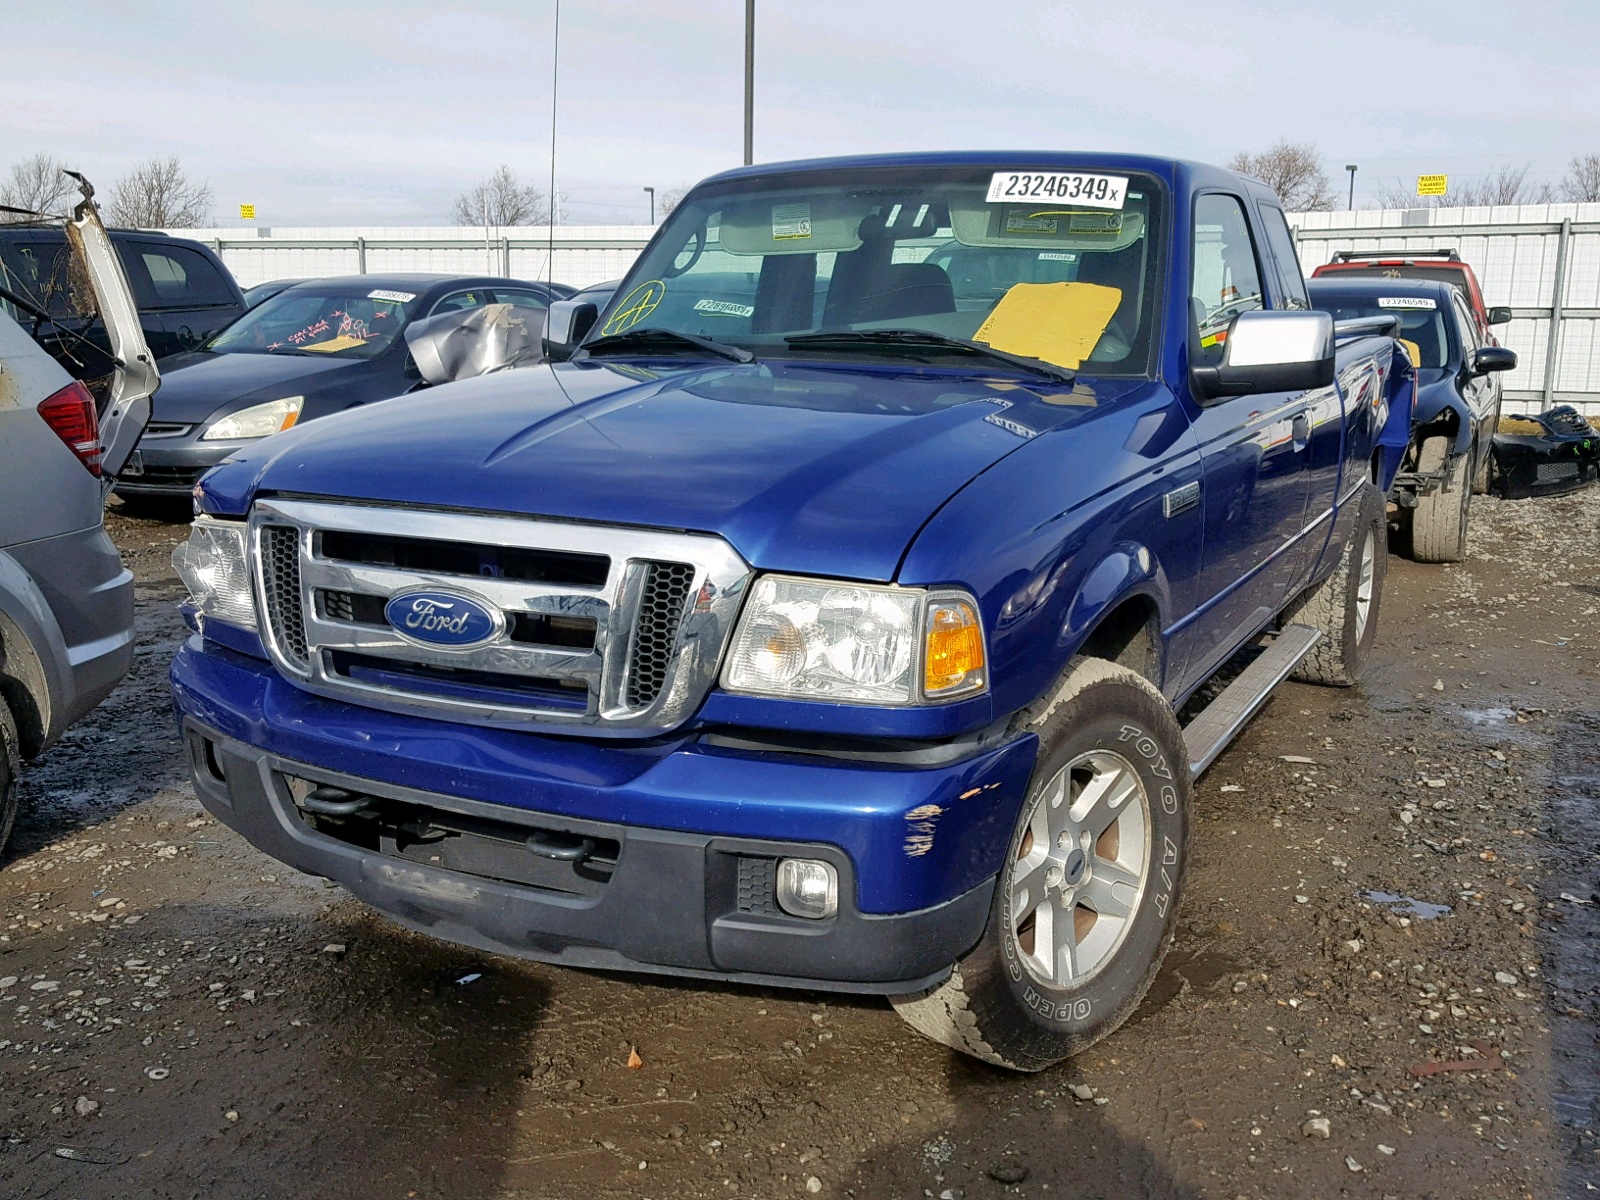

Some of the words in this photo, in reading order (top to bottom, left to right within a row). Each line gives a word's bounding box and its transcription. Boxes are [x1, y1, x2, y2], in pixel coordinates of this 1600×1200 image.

[1005, 175, 1108, 200] 23246349
[405, 598, 470, 634] Ford
[1118, 724, 1178, 815] TOYO
[1154, 834, 1178, 920] A/T
[1023, 985, 1091, 1022] OPEN
